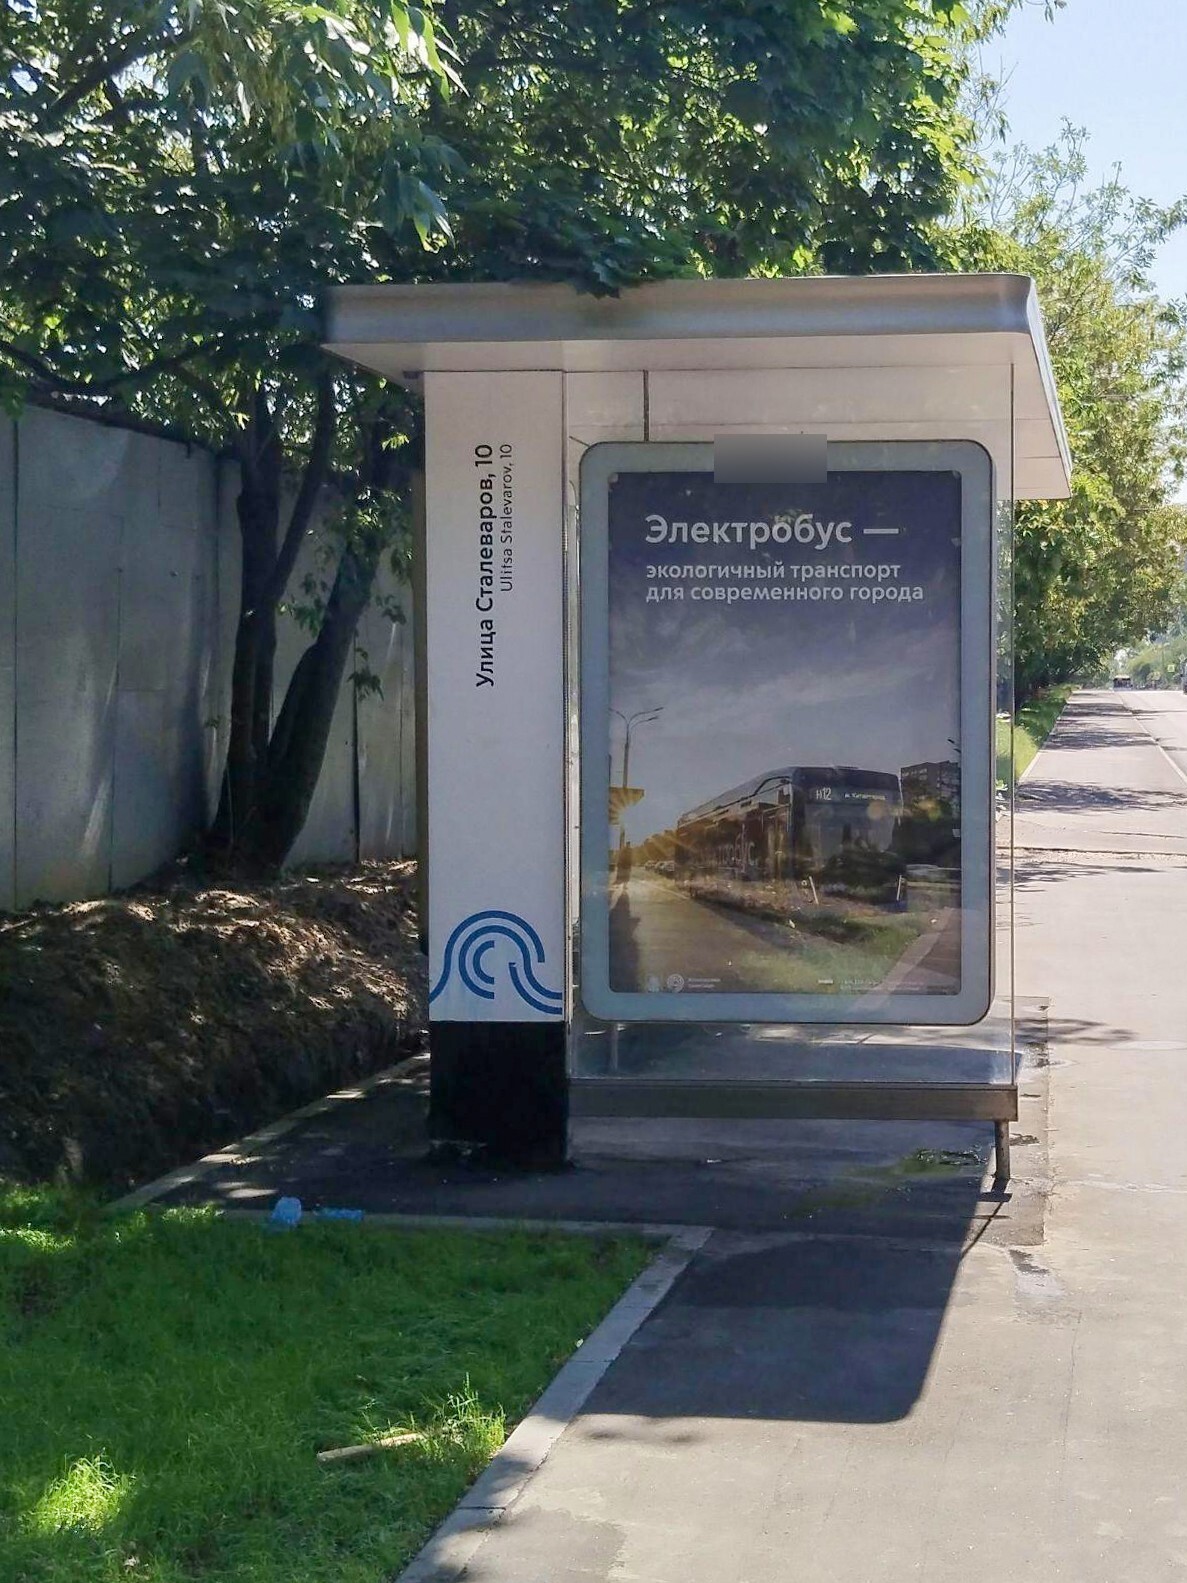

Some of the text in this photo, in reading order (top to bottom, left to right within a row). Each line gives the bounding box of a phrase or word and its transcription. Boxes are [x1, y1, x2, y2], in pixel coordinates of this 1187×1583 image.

[500, 444, 515, 592] Ulitsa Stalevarov, 10
[645, 513, 853, 551] Электробус
[475, 444, 497, 687] Улица Сталеваров, 10
[646, 561, 901, 582] экологичный транспорт
[646, 586, 924, 604] для современного города
